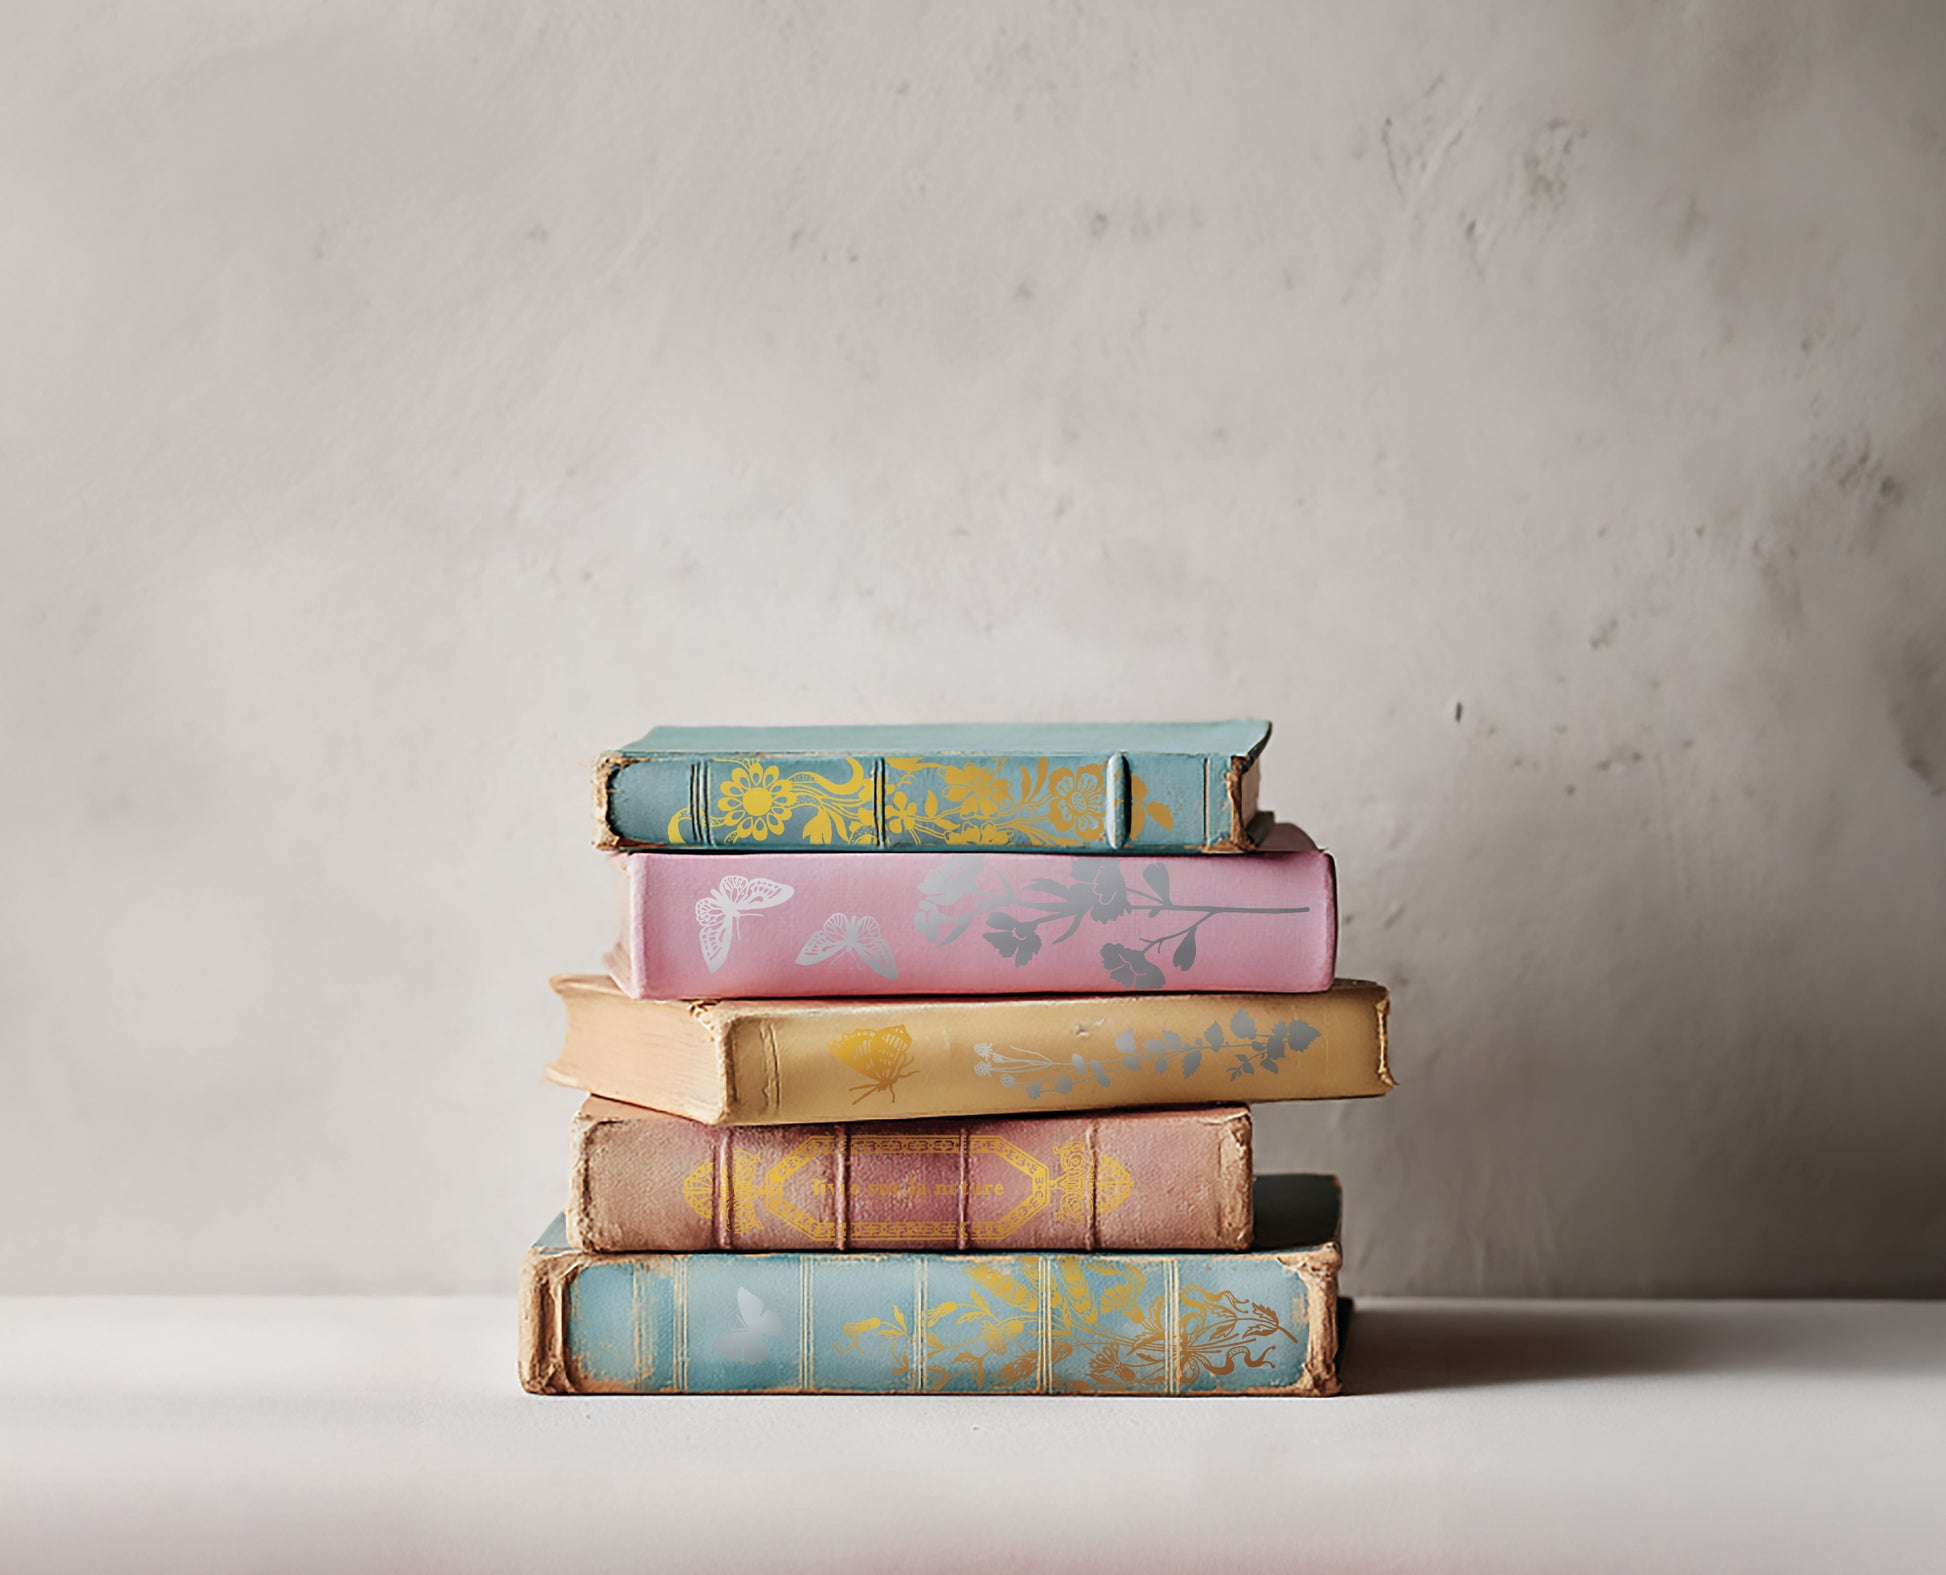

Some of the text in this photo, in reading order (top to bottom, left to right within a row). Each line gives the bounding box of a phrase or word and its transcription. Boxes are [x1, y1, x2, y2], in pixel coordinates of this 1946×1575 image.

[867, 1183, 902, 1197] sur
[909, 1178, 927, 1197] la
[935, 1179, 1005, 1197] nature
